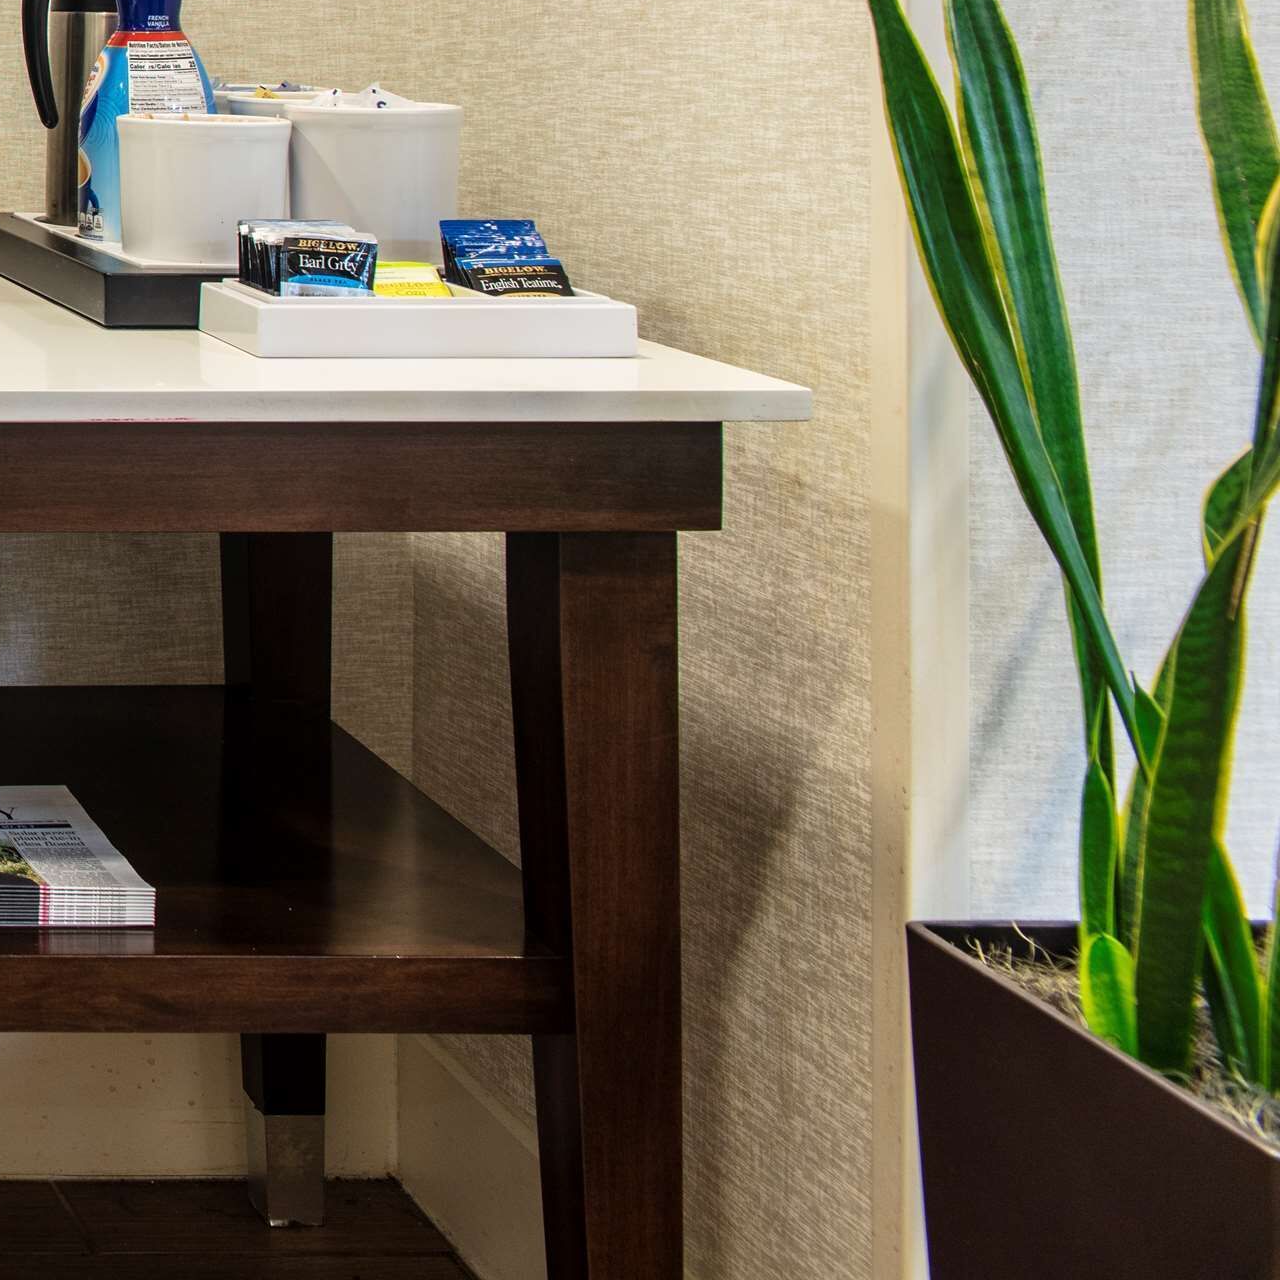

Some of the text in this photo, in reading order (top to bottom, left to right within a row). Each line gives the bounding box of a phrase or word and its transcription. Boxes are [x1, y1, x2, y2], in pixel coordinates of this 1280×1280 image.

[299, 254, 359, 273] Earl Grey
[480, 277, 559, 291] English Teatime
